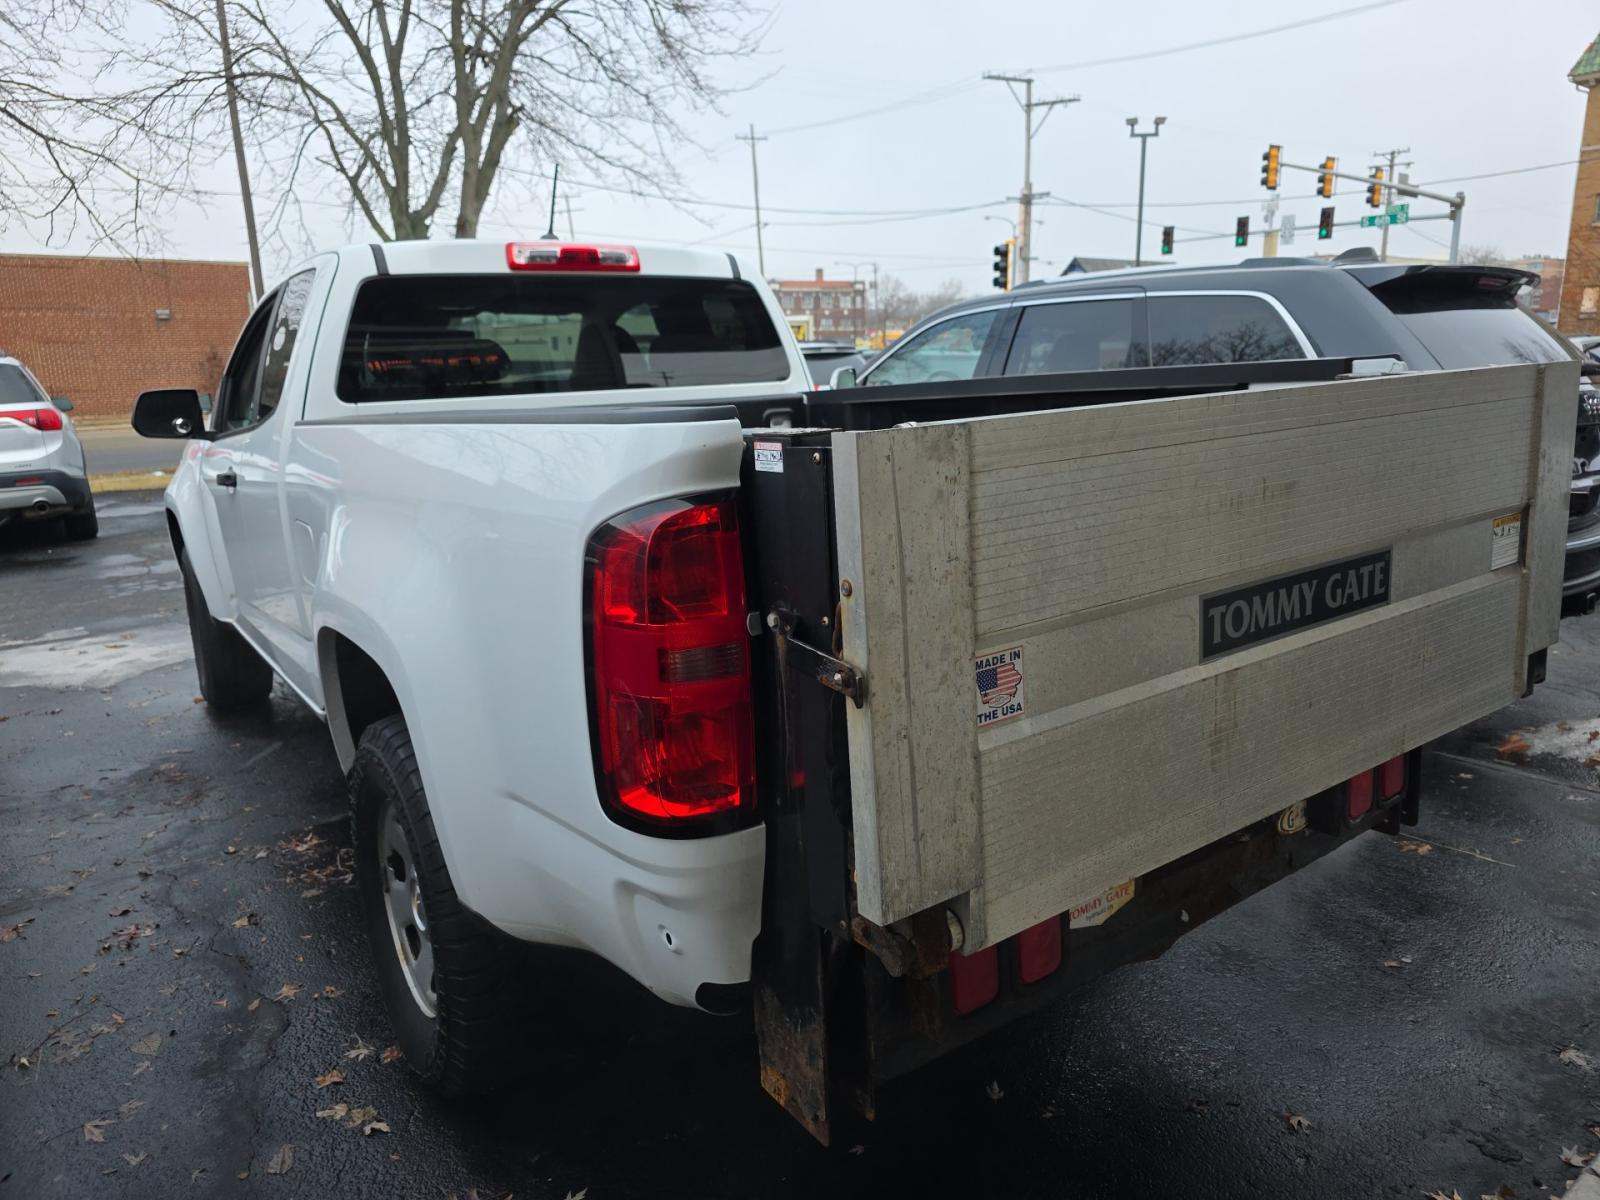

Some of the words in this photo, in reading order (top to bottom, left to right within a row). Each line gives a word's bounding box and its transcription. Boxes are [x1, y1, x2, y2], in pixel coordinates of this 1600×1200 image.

[1207, 579, 1319, 645] TOMMY
[1325, 561, 1386, 609] GATE
[975, 654, 1006, 670] MADE
[1009, 650, 1020, 661] IN
[977, 709, 998, 723] THE
[1001, 703, 1022, 716] USA
[1106, 886, 1130, 903] GATE
